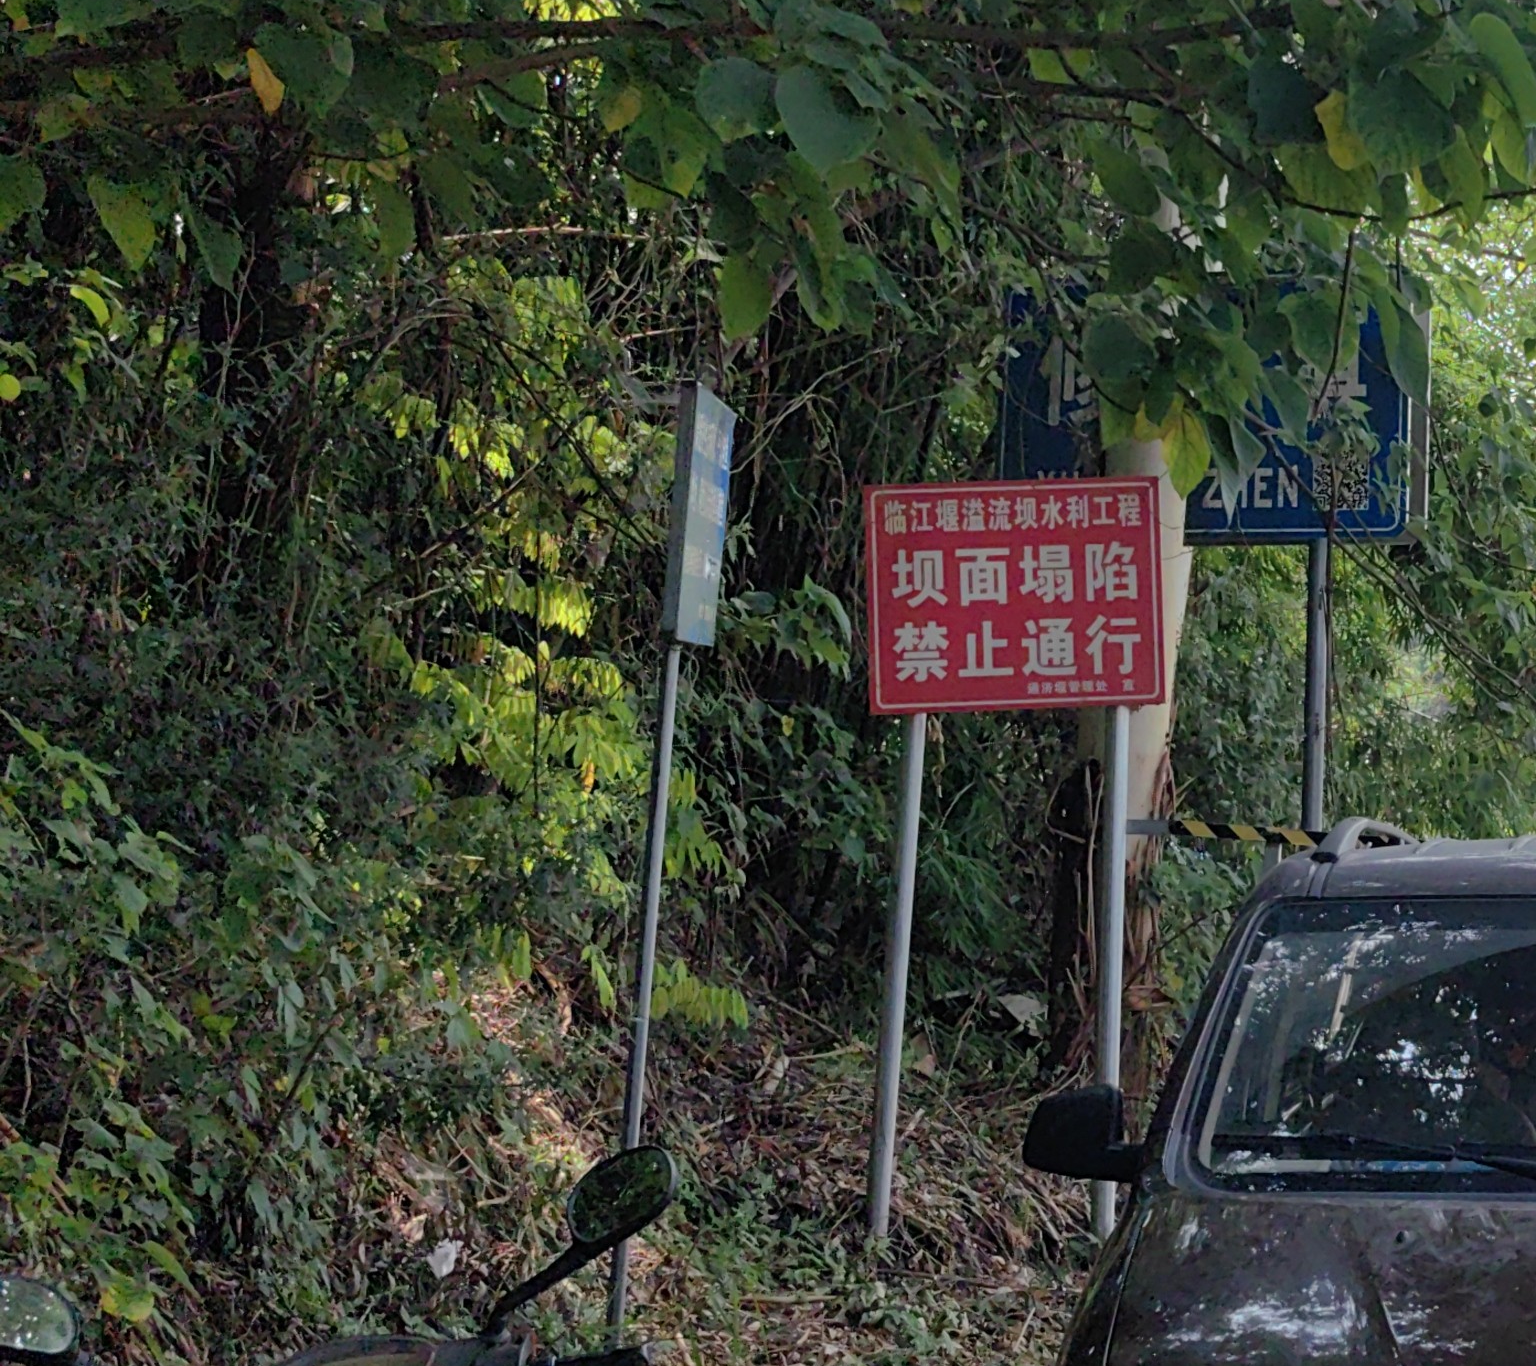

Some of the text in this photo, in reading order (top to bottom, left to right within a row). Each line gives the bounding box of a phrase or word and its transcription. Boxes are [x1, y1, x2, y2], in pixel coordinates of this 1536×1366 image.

[884, 493, 1142, 535] 临江堰溢流坝水利工程
[891, 541, 1139, 608] 坝面塌陷
[893, 614, 1141, 682] 禁止通行
